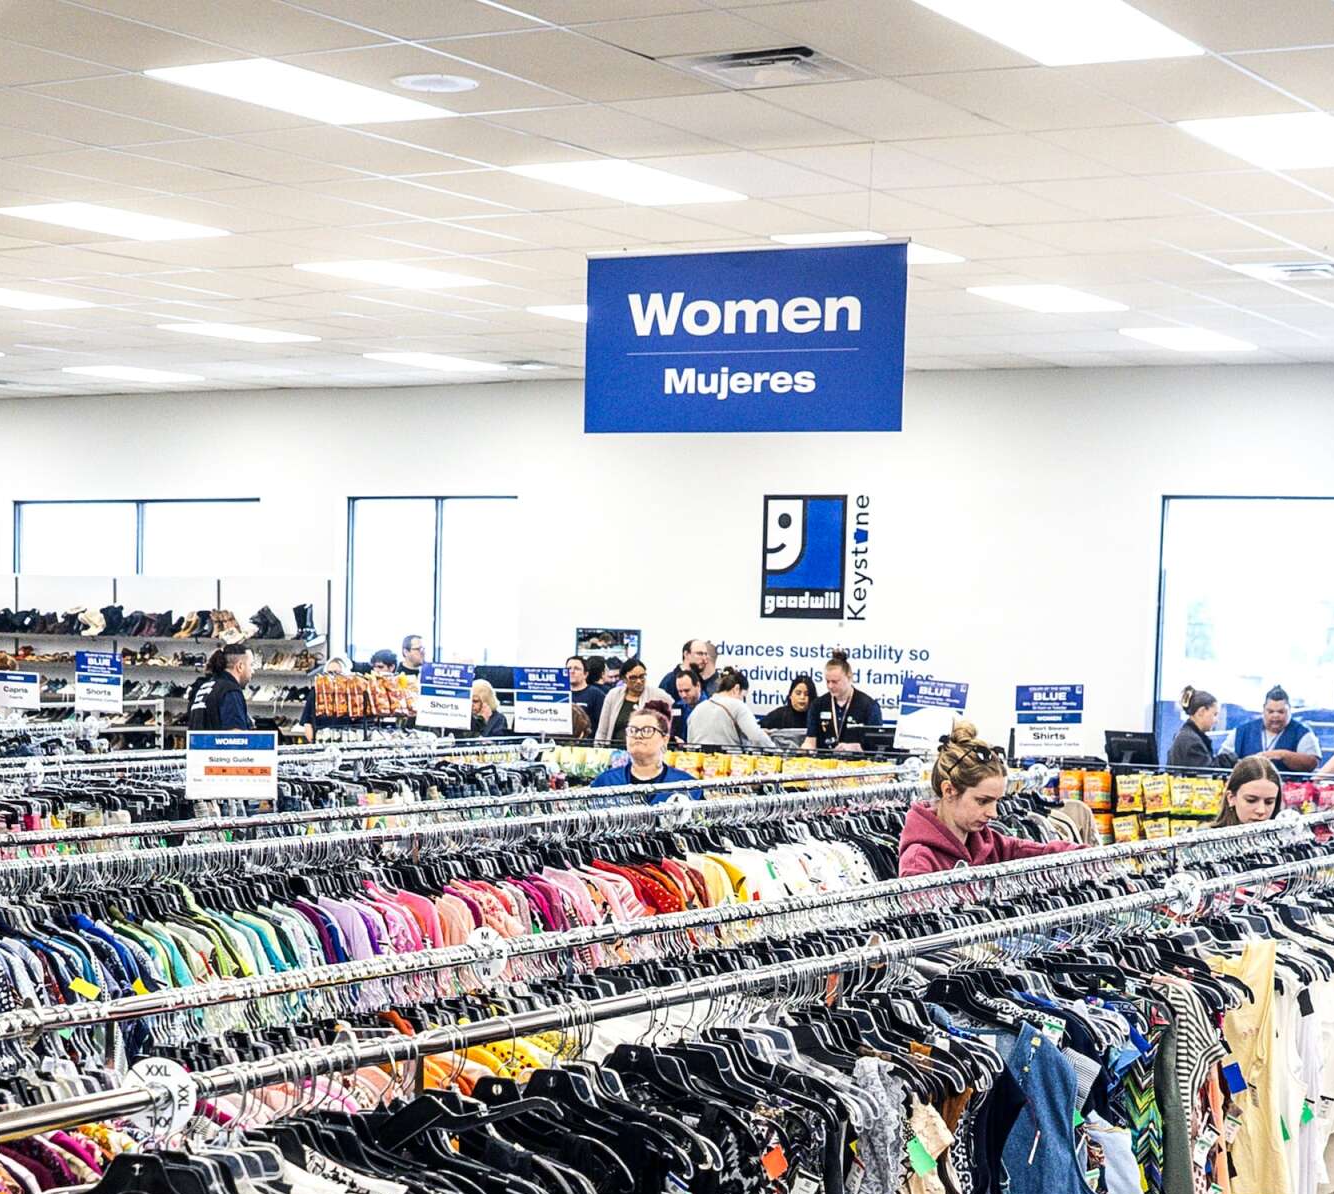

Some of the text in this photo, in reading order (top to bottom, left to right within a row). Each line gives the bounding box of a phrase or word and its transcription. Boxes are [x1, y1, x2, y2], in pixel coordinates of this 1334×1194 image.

[627, 292, 861, 336] Women
[663, 367, 816, 400] Mujeres
[764, 591, 841, 614] goodwill
[713, 640, 784, 657] dvances
[909, 648, 930, 661] so
[433, 668, 461, 678] BLUE
[528, 674, 556, 682] BLUE
[752, 690, 788, 705] thriv
[919, 686, 951, 698] BLUE
[1033, 692, 1067, 701] BLUE
[430, 701, 459, 710] Shorts
[527, 707, 559, 715] Shorts
[1033, 732, 1066, 740] Shirts
[145, 1064, 171, 1076] XXL
[178, 1084, 189, 1110] XXL
